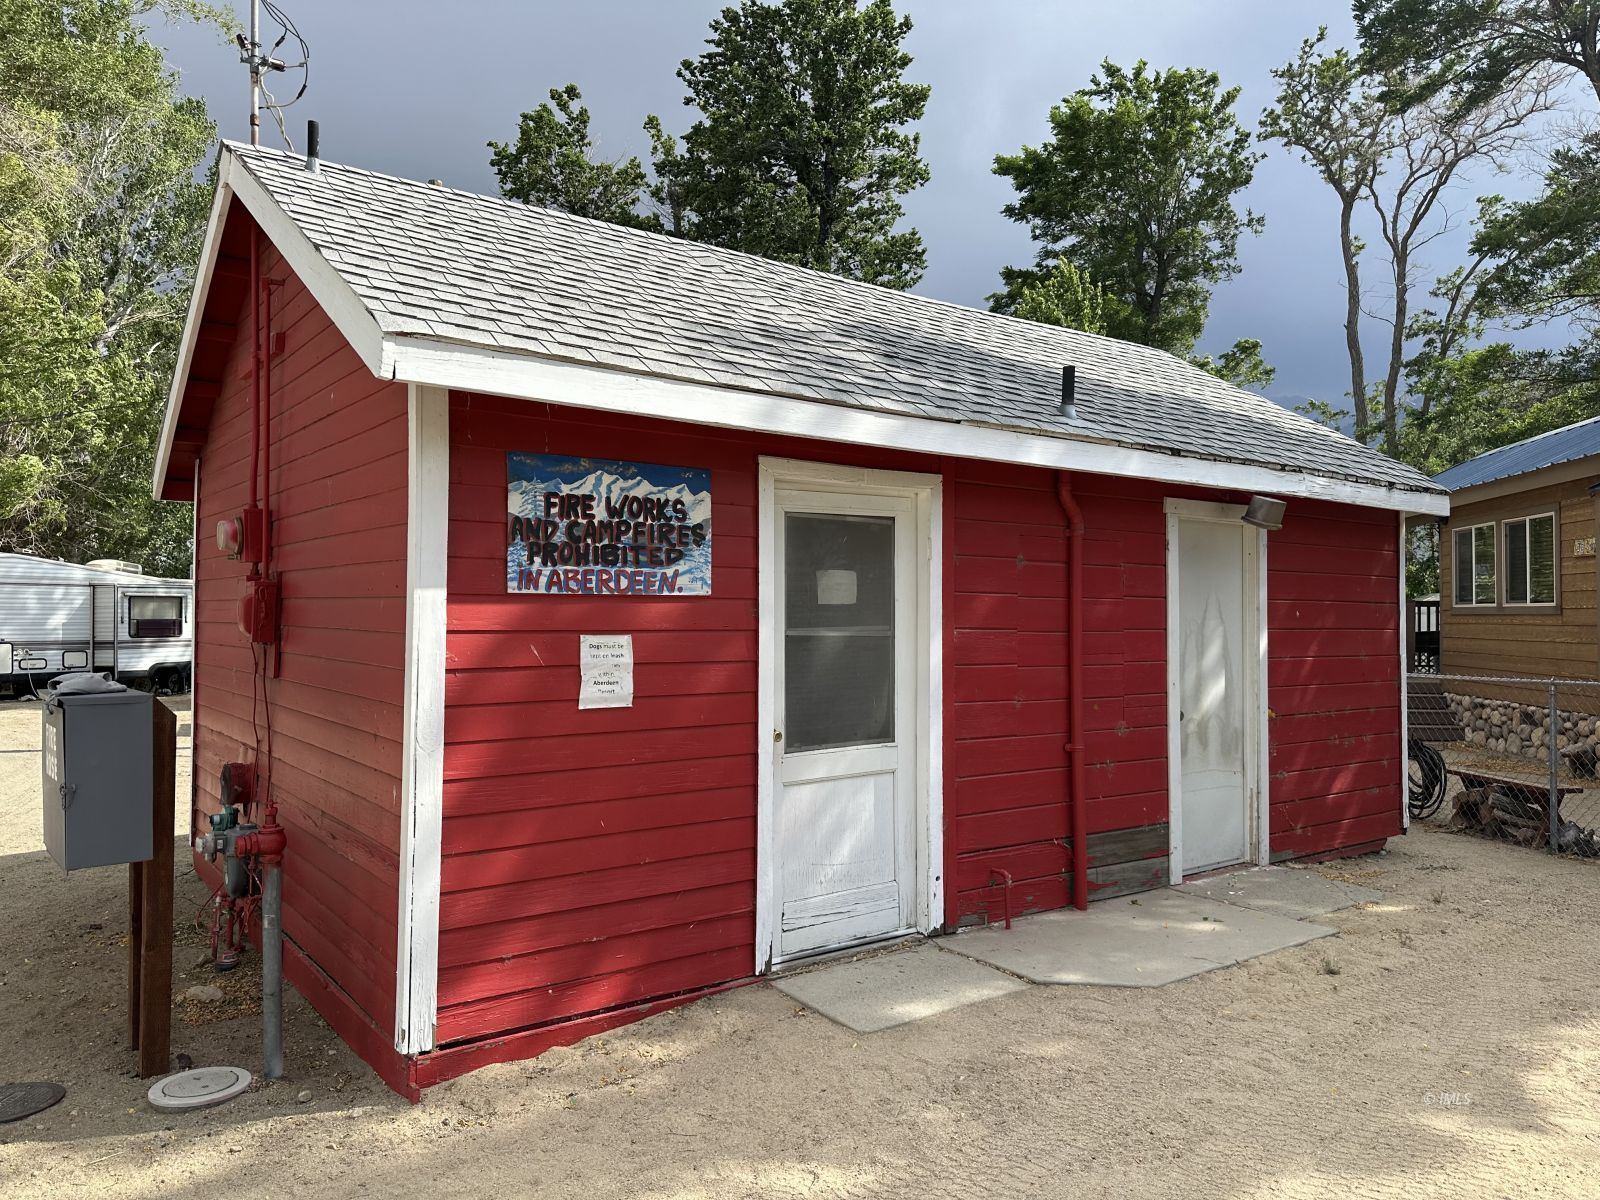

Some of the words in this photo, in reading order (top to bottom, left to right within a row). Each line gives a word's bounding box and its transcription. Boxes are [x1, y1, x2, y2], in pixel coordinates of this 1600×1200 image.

[543, 492, 596, 521] FIRE
[605, 494, 688, 523] WORKS
[510, 515, 560, 543] AND
[565, 519, 706, 548] CAMPFIRES
[526, 541, 684, 567] PROHIBITED
[516, 568, 543, 592] IN
[545, 568, 684, 594] ABERDEEN.
